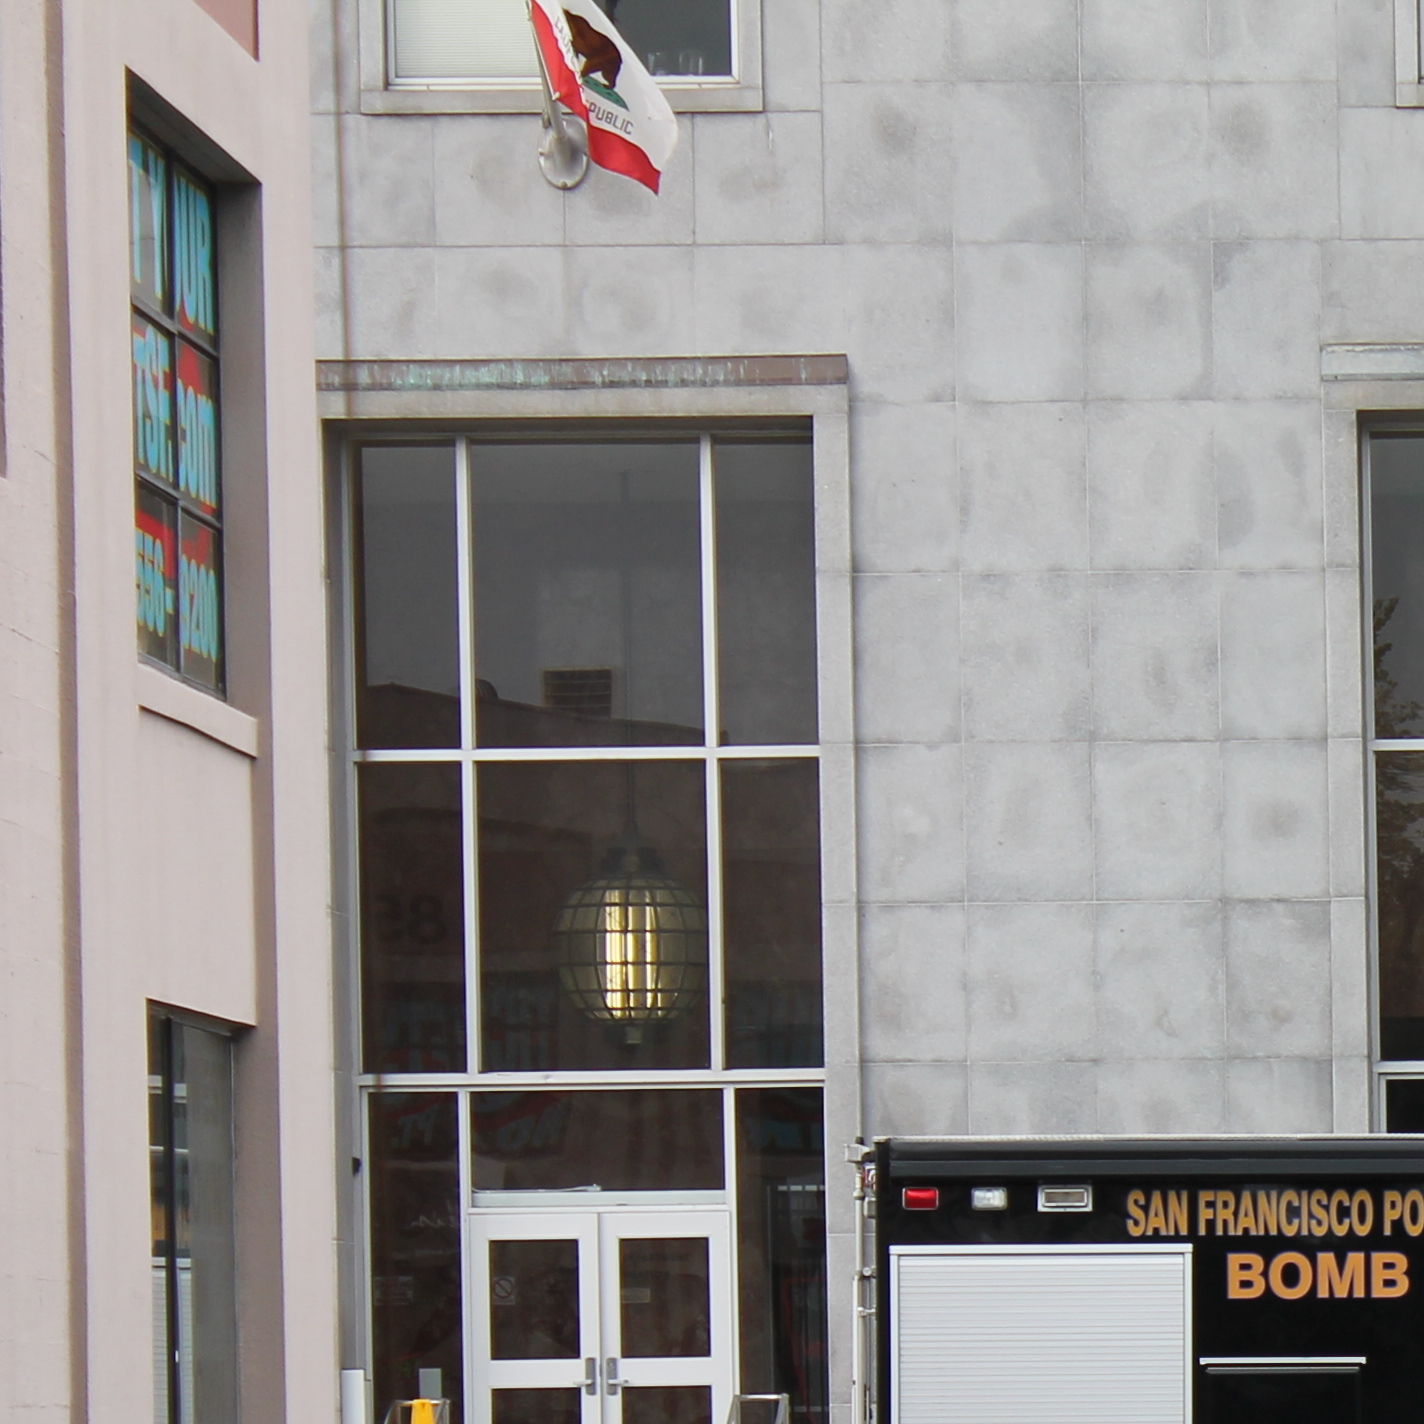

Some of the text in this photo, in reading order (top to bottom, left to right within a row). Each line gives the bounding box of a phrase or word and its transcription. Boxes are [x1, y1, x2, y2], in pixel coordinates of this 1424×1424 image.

[1126, 1189, 1188, 1236] SAN
[1198, 1189, 1374, 1236] FRANCISCO
[1227, 1251, 1410, 1299] BOMB
